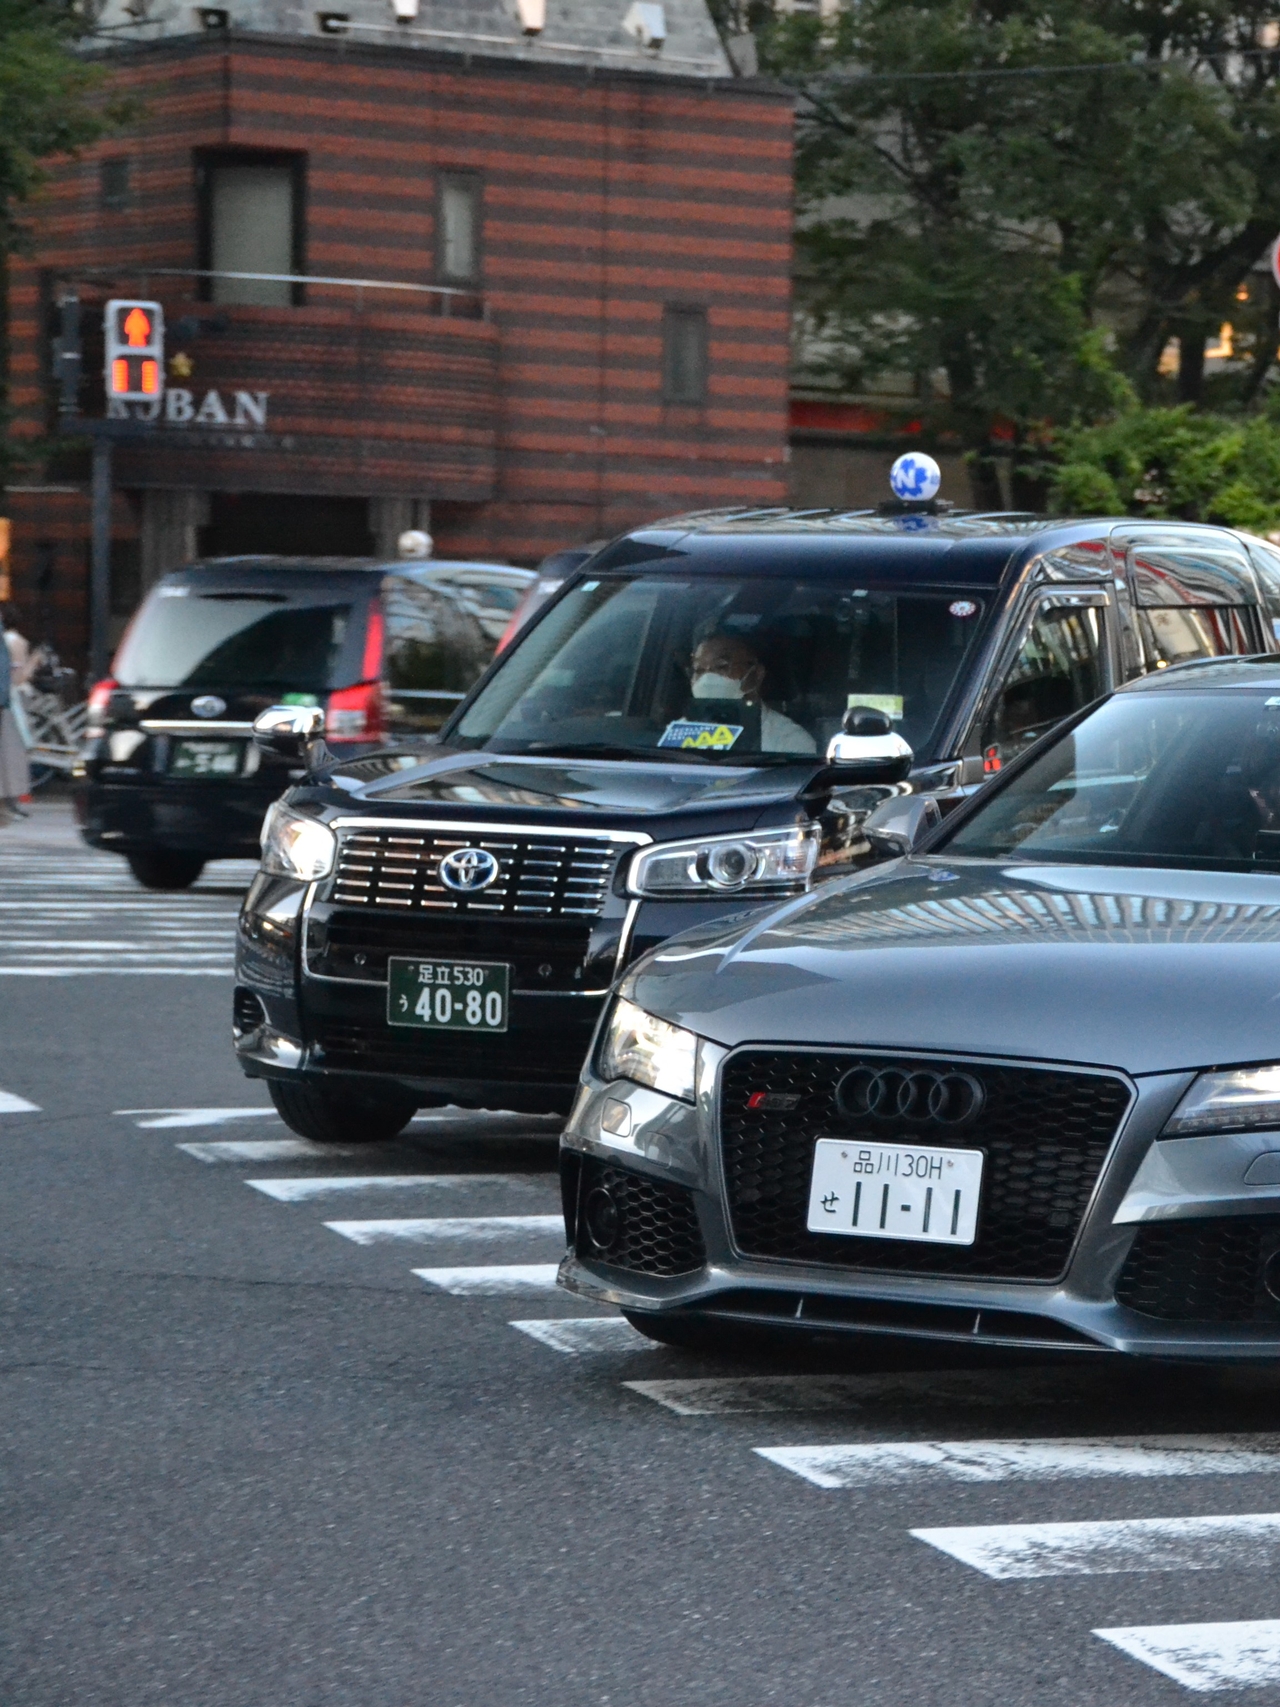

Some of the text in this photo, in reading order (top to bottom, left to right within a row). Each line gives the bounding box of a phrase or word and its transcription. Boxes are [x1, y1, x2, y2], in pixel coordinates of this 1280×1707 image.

[399, 987, 502, 1026] う 40-80
[820, 1181, 962, 1236] せ 11-11
